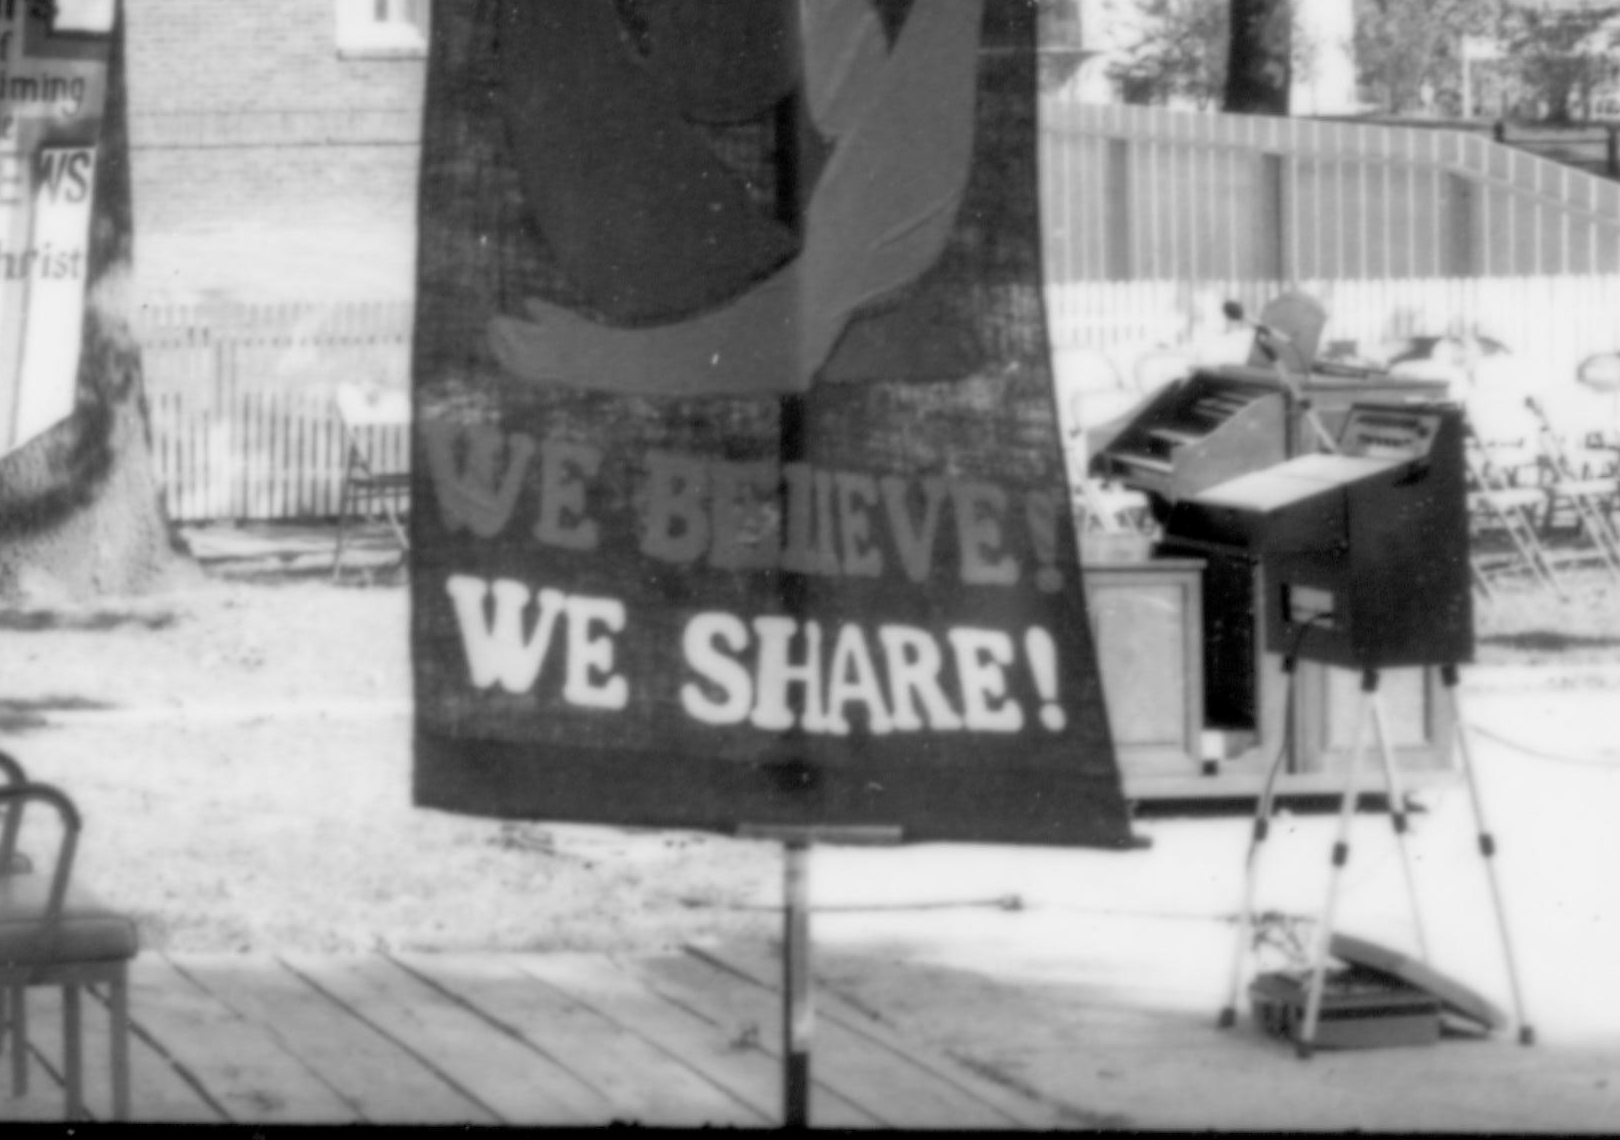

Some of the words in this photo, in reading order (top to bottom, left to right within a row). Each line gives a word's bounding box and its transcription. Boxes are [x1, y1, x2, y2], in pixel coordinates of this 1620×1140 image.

[420, 418, 604, 552] WE
[637, 449, 1068, 594] BELIEVE!
[445, 574, 629, 710] WE
[680, 611, 1068, 735] SHARE!
